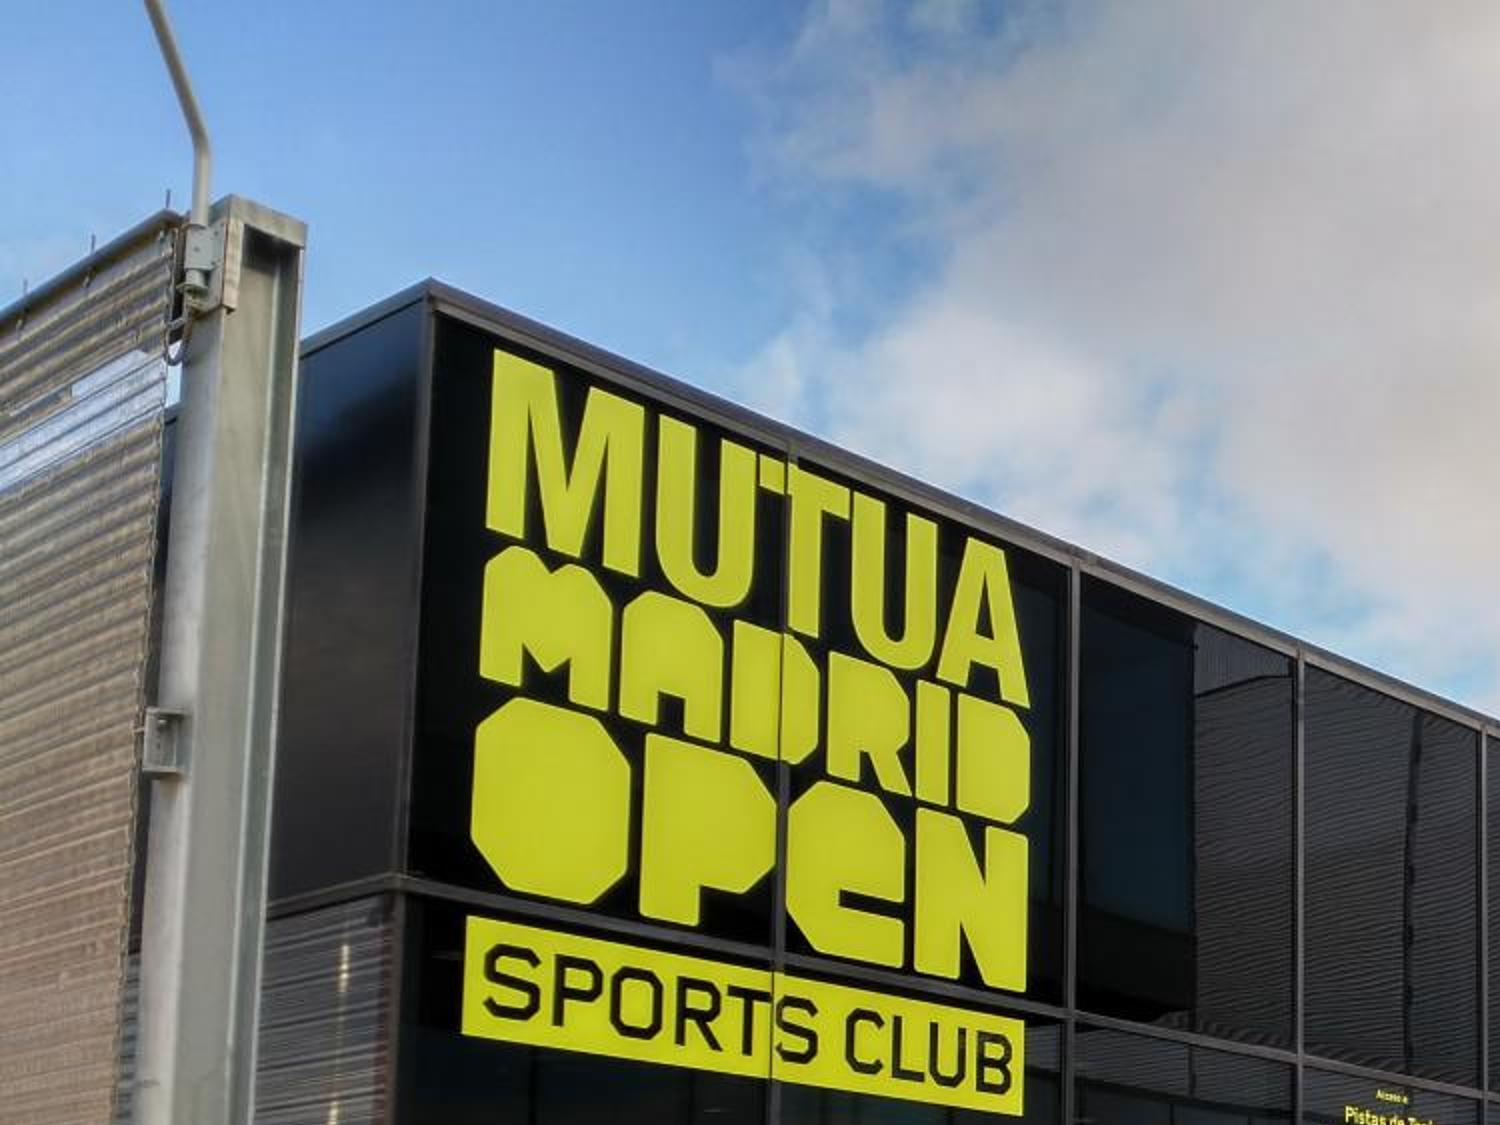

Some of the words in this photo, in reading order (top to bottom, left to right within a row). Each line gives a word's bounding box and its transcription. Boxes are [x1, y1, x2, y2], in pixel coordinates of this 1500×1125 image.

[486, 348, 1031, 709] MUTUA
[479, 545, 1031, 825] MADRID
[470, 696, 1029, 994] OPEN
[483, 943, 819, 1066] SPORTS
[844, 1006, 1013, 1096] CLUB
